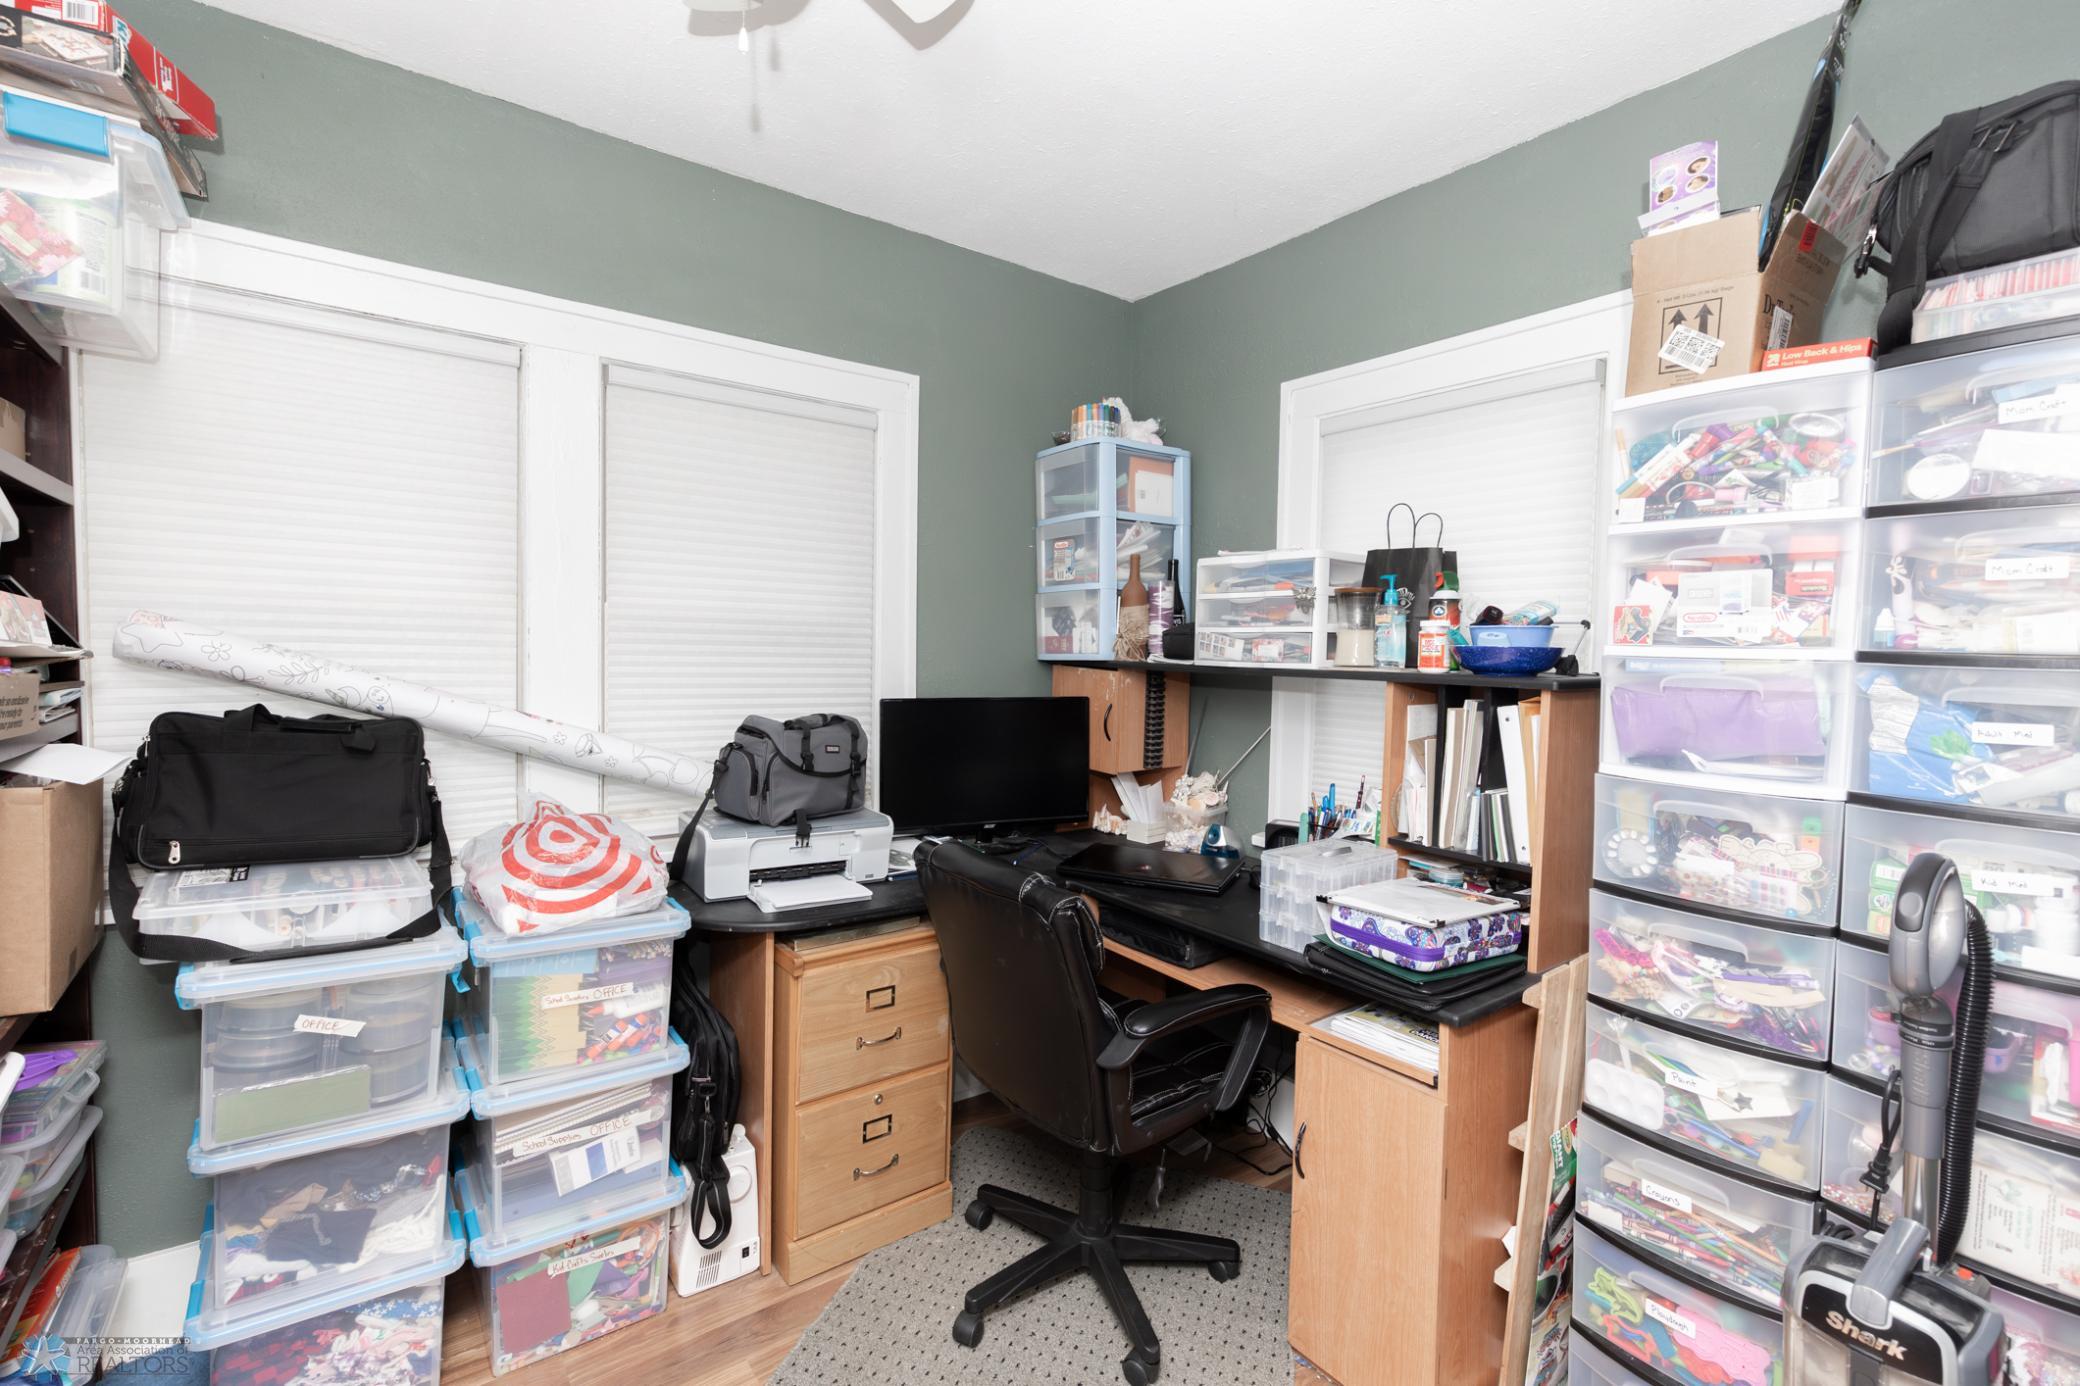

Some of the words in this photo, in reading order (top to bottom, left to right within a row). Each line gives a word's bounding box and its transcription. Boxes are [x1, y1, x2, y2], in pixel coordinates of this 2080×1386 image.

[1782, 351, 1802, 360] Low
[1804, 347, 1828, 357] Back
[1830, 345, 1838, 354] &
[1841, 344, 1862, 353] Hips
[593, 984, 625, 999] OFFICE
[302, 1019, 339, 1031] OFFICE
[522, 1140, 546, 1152] School
[590, 1117, 631, 1136] OFFICE
[1825, 1310, 1908, 1361] Shark
